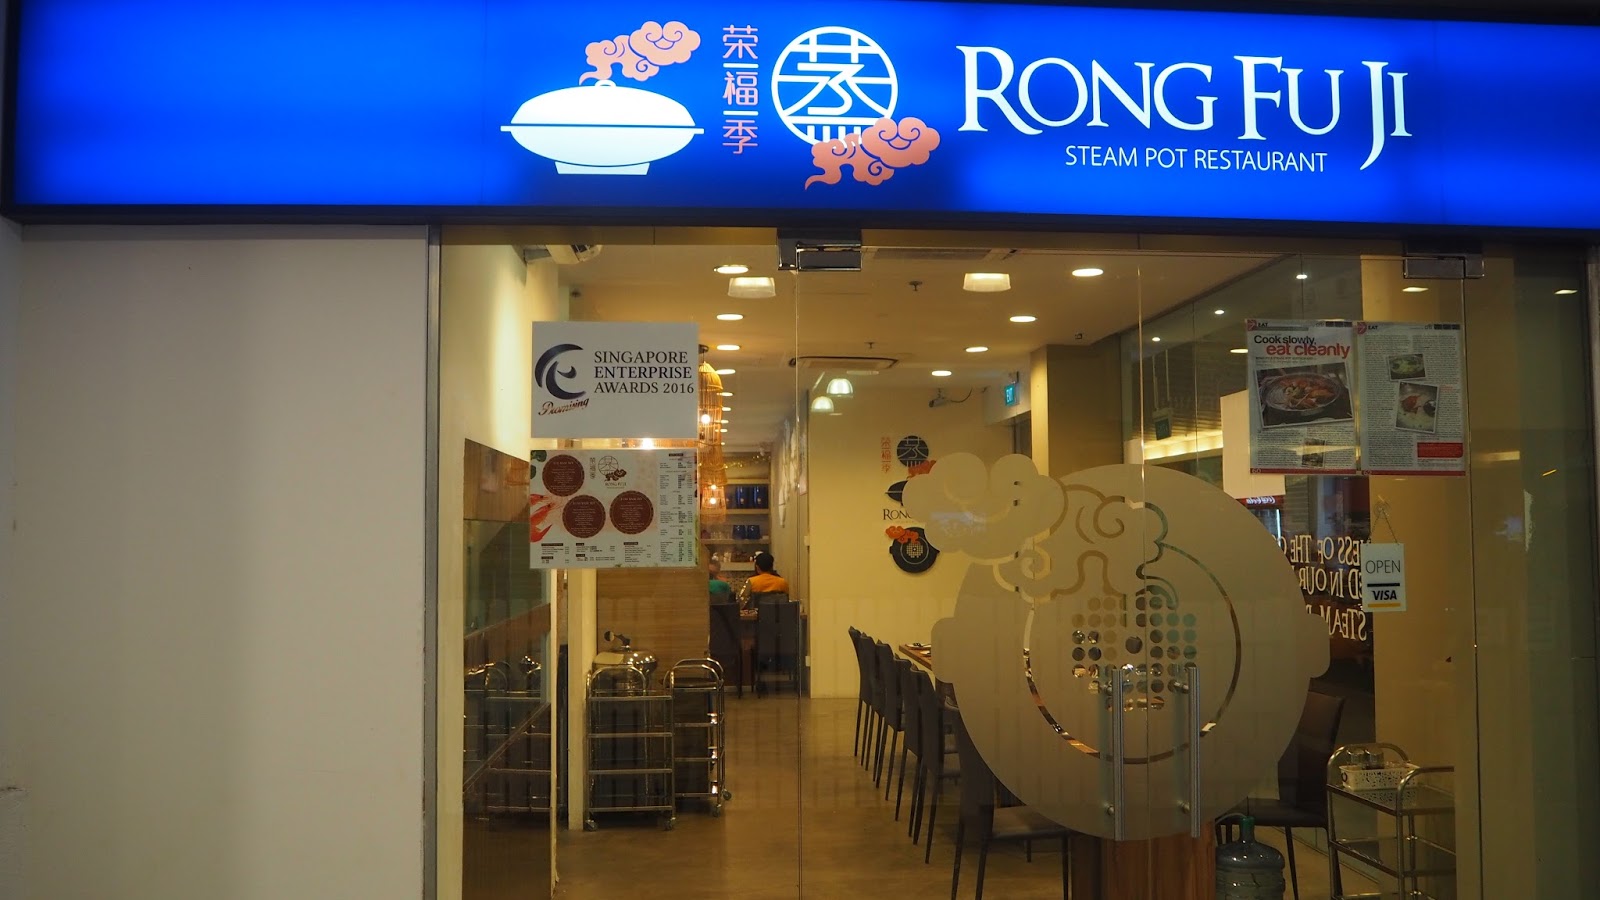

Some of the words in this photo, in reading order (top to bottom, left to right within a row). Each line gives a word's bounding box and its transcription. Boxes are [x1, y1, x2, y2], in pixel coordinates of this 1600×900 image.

[722, 24, 759, 155] 荣福季
[955, 45, 1218, 136] RONG
[1233, 55, 1344, 140] FU
[1360, 60, 1412, 171] JI
[1065, 145, 1137, 168] STEAM
[1145, 147, 1189, 169] POT
[1194, 149, 1328, 173] RESTAURANT
[1254, 335, 1281, 344] Cook
[1282, 335, 1317, 346] slowly,
[594, 351, 688, 364] SINGAPORE
[1266, 343, 1291, 356] eat
[1294, 342, 1351, 359] cleanly
[594, 366, 692, 379] ENTERPRISE
[593, 382, 659, 394] AWARDS
[663, 382, 694, 394] 2016
[1365, 559, 1401, 575] OPEN
[1372, 590, 1397, 600] VISA
